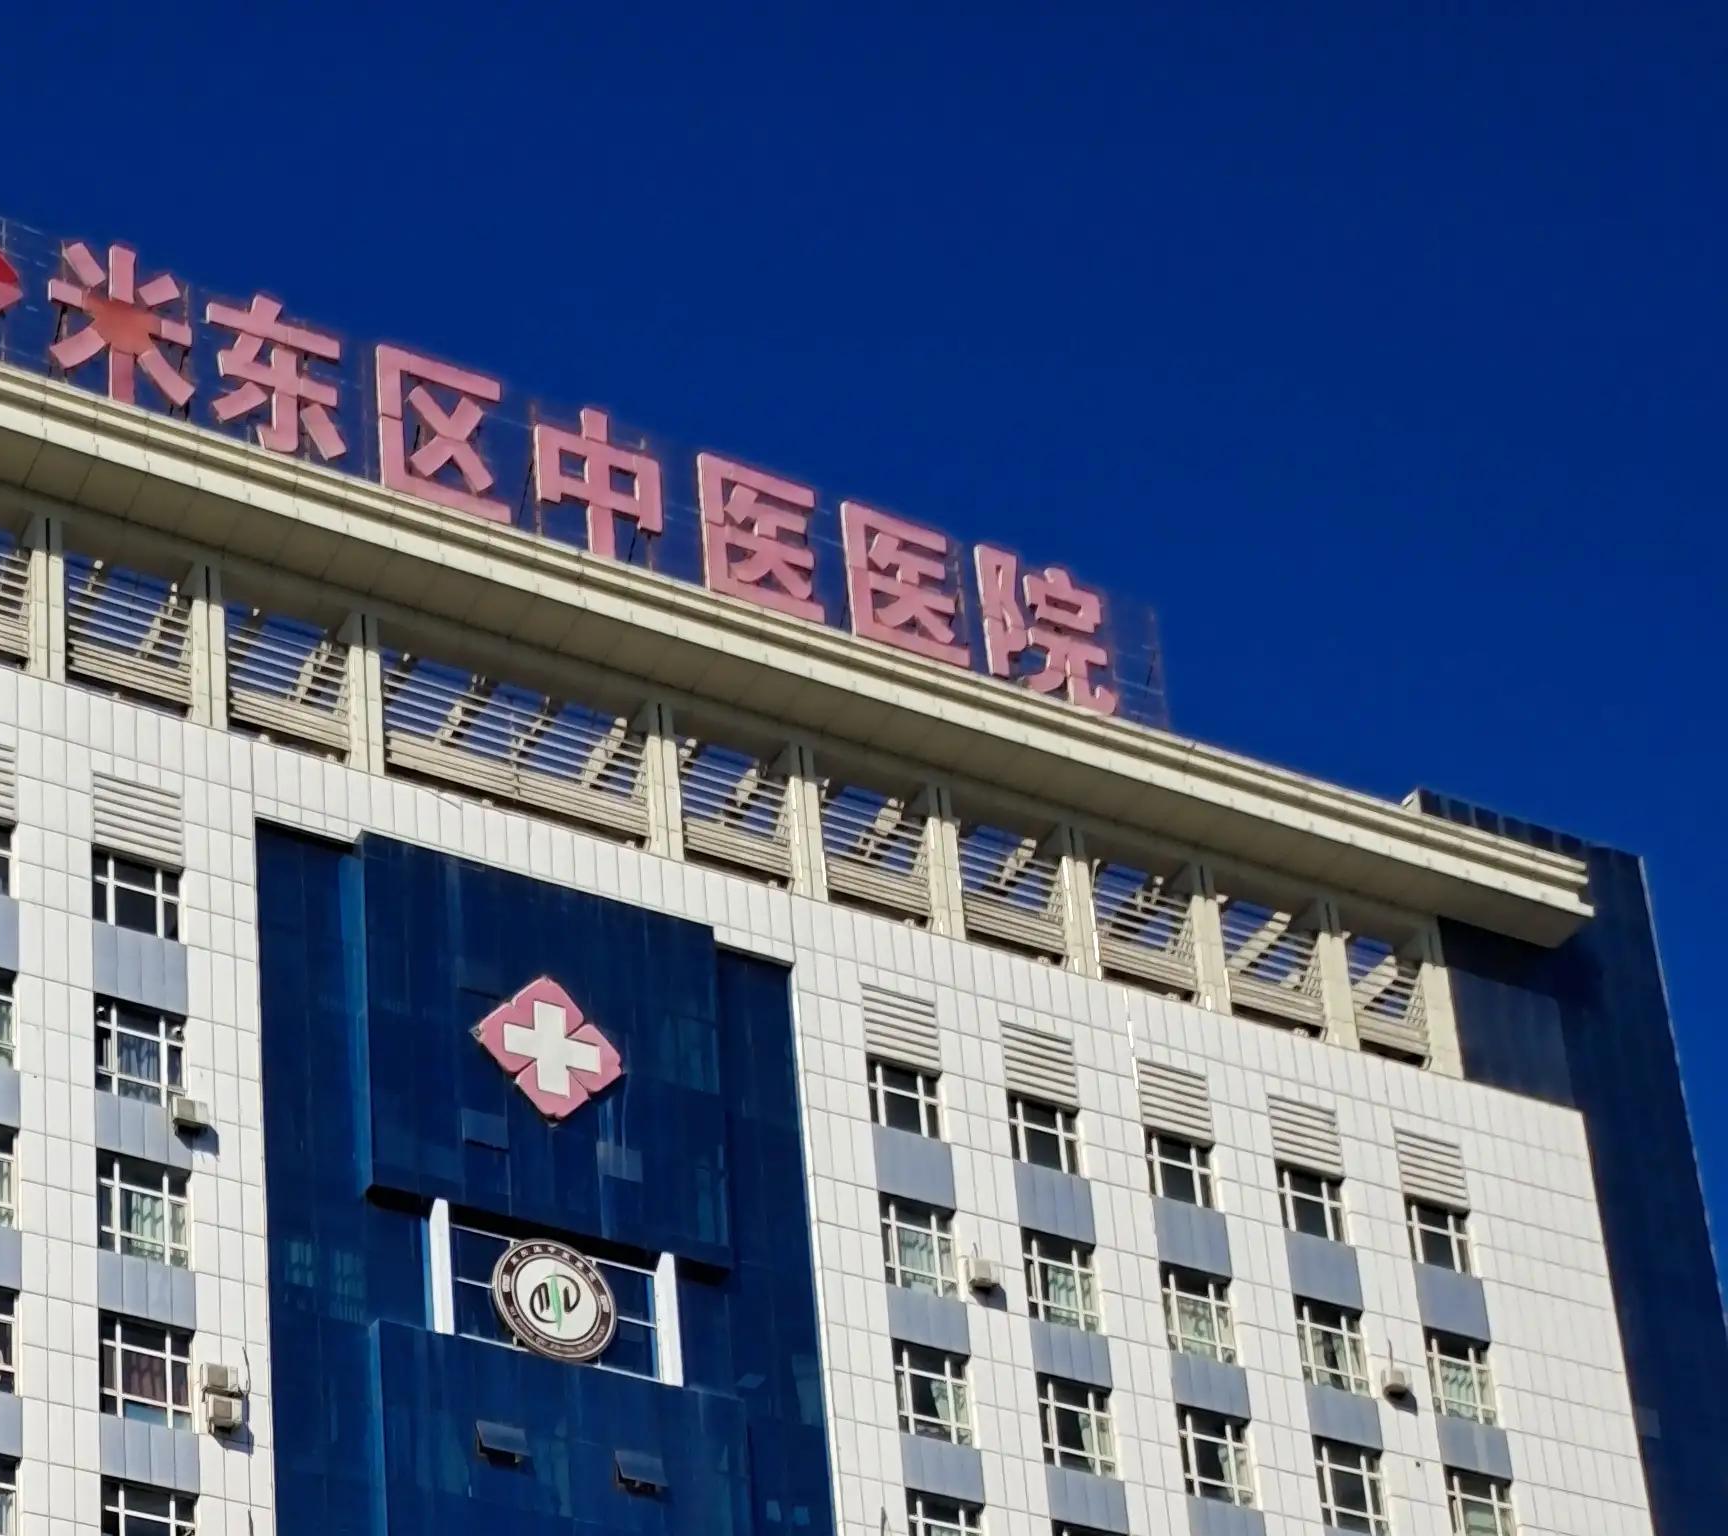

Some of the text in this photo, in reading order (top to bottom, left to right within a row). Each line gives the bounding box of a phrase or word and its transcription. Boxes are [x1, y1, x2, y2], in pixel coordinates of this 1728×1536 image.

[48, 241, 1120, 718] 米东区中医医院
